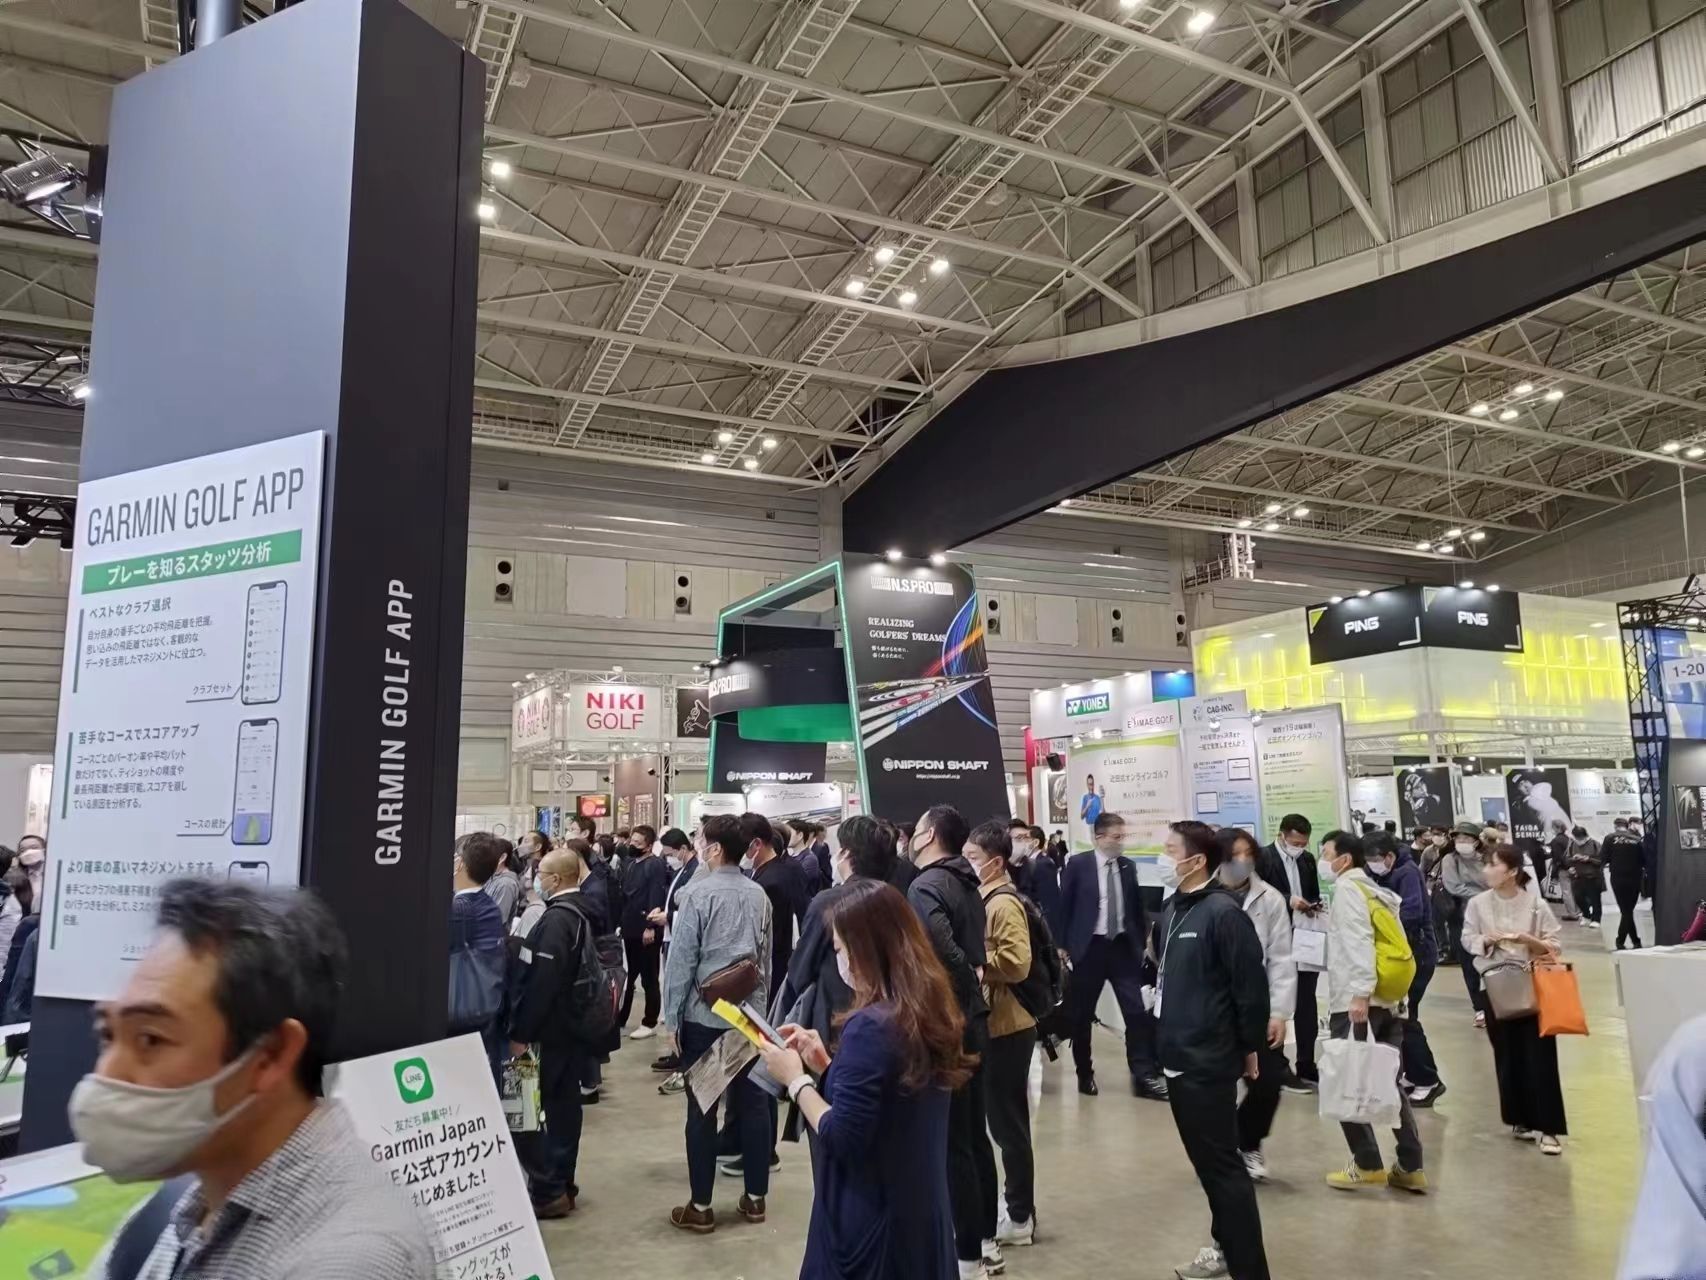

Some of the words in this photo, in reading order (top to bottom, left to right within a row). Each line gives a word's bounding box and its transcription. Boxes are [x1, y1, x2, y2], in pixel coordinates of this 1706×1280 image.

[87, 493, 177, 546] GARMIN
[184, 478, 247, 529] GOLF
[252, 467, 304, 517] APP
[108, 541, 272, 585] プレーを知るスタッツ分析
[89, 597, 172, 618] ベストなクラブ選択
[386, 579, 413, 640] APP
[868, 617, 914, 628] REALIZING
[1344, 616, 1380, 635] PING
[1457, 610, 1489, 626] PING
[912, 632, 947, 642] DREAMS
[1672, 663, 1705, 678] 1-20
[192, 682, 232, 696] クラブセット
[381, 648, 410, 727] GOLF
[587, 692, 644, 709] NIKI
[1081, 696, 1108, 712] YONEX
[586, 712, 644, 730] GOLF
[78, 724, 200, 744] 苦手なコースでスコアアップ
[894, 760, 944, 769] NIPPON
[947, 761, 989, 770] SHAFT
[735, 772, 777, 781] NIPPON
[778, 772, 813, 780] SHAFT
[374, 739, 406, 865] GARMIN
[184, 818, 226, 829] コースの統計
[67, 860, 214, 875] より確率の高いマネジメントをする
[405, 1072, 423, 1084] LINE
[370, 1129, 435, 1163] Garmin
[439, 1116, 487, 1143] Japan
[453, 1242, 511, 1279] ングッズが
